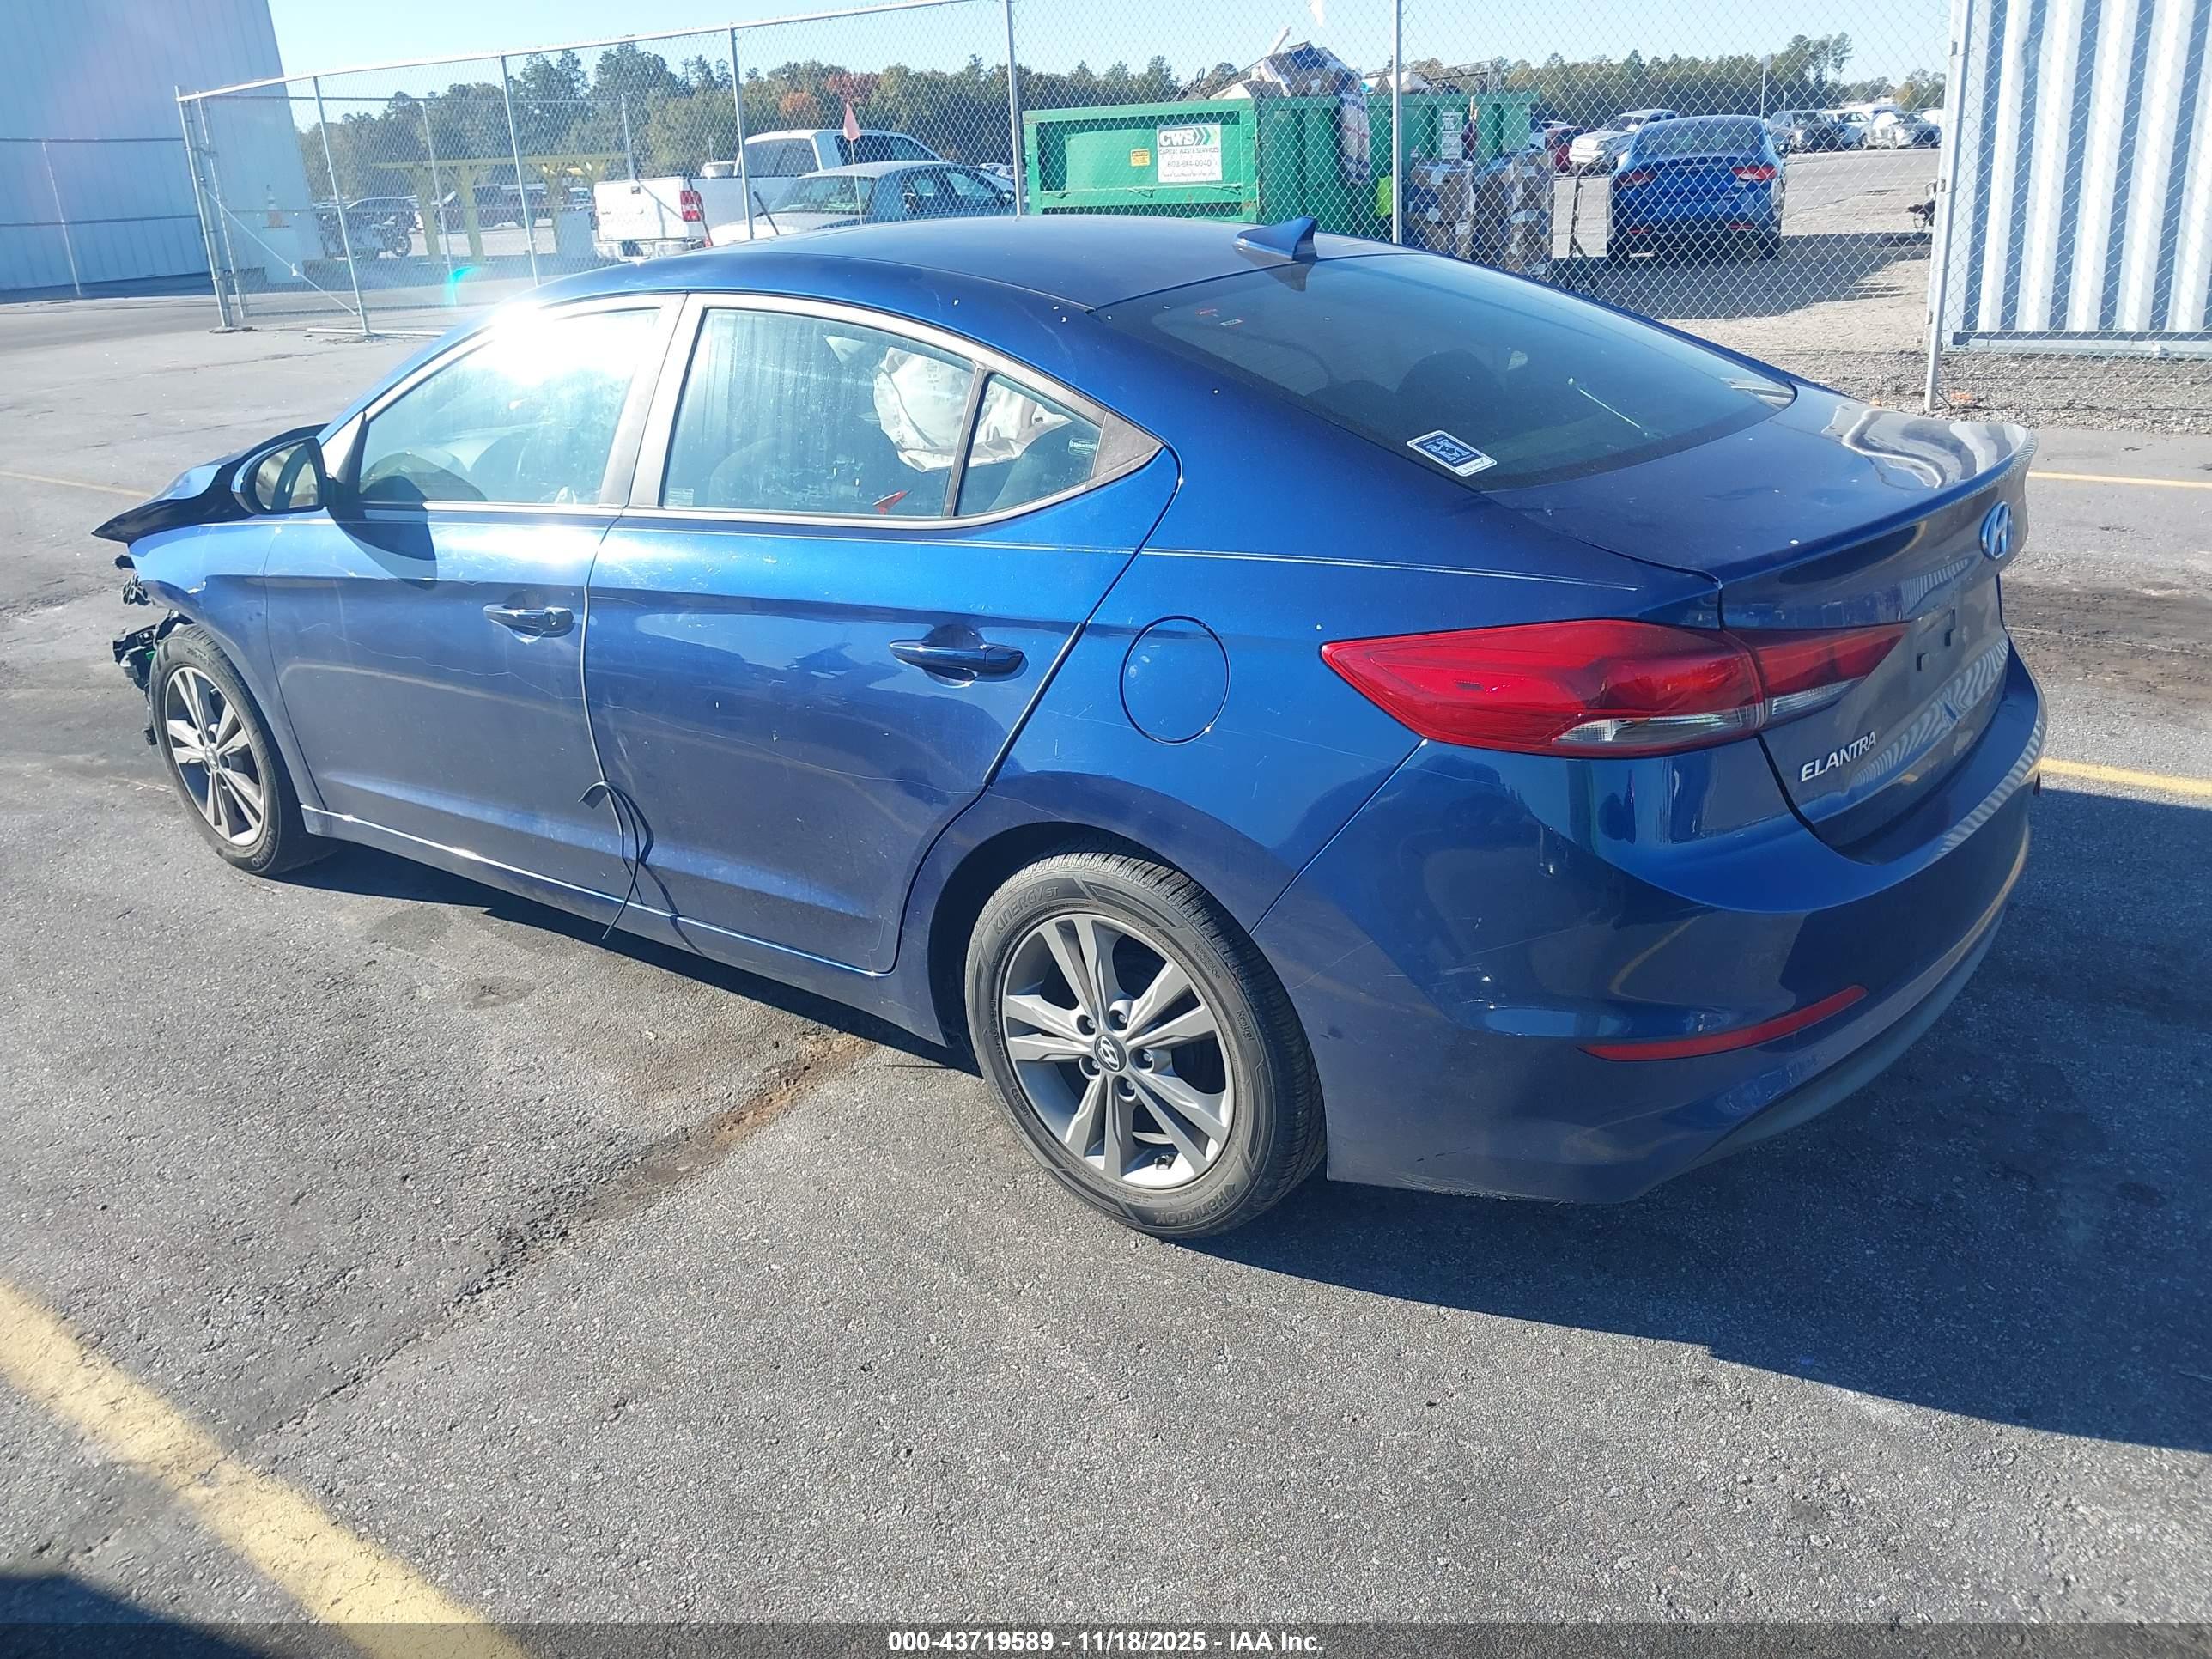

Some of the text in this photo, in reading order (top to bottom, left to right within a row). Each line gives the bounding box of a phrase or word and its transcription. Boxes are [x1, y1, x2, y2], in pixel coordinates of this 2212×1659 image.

[1159, 128, 1194, 146] CWS
[1801, 731, 1876, 782] ELANTRA
[1046, 886, 1059, 897] ST
